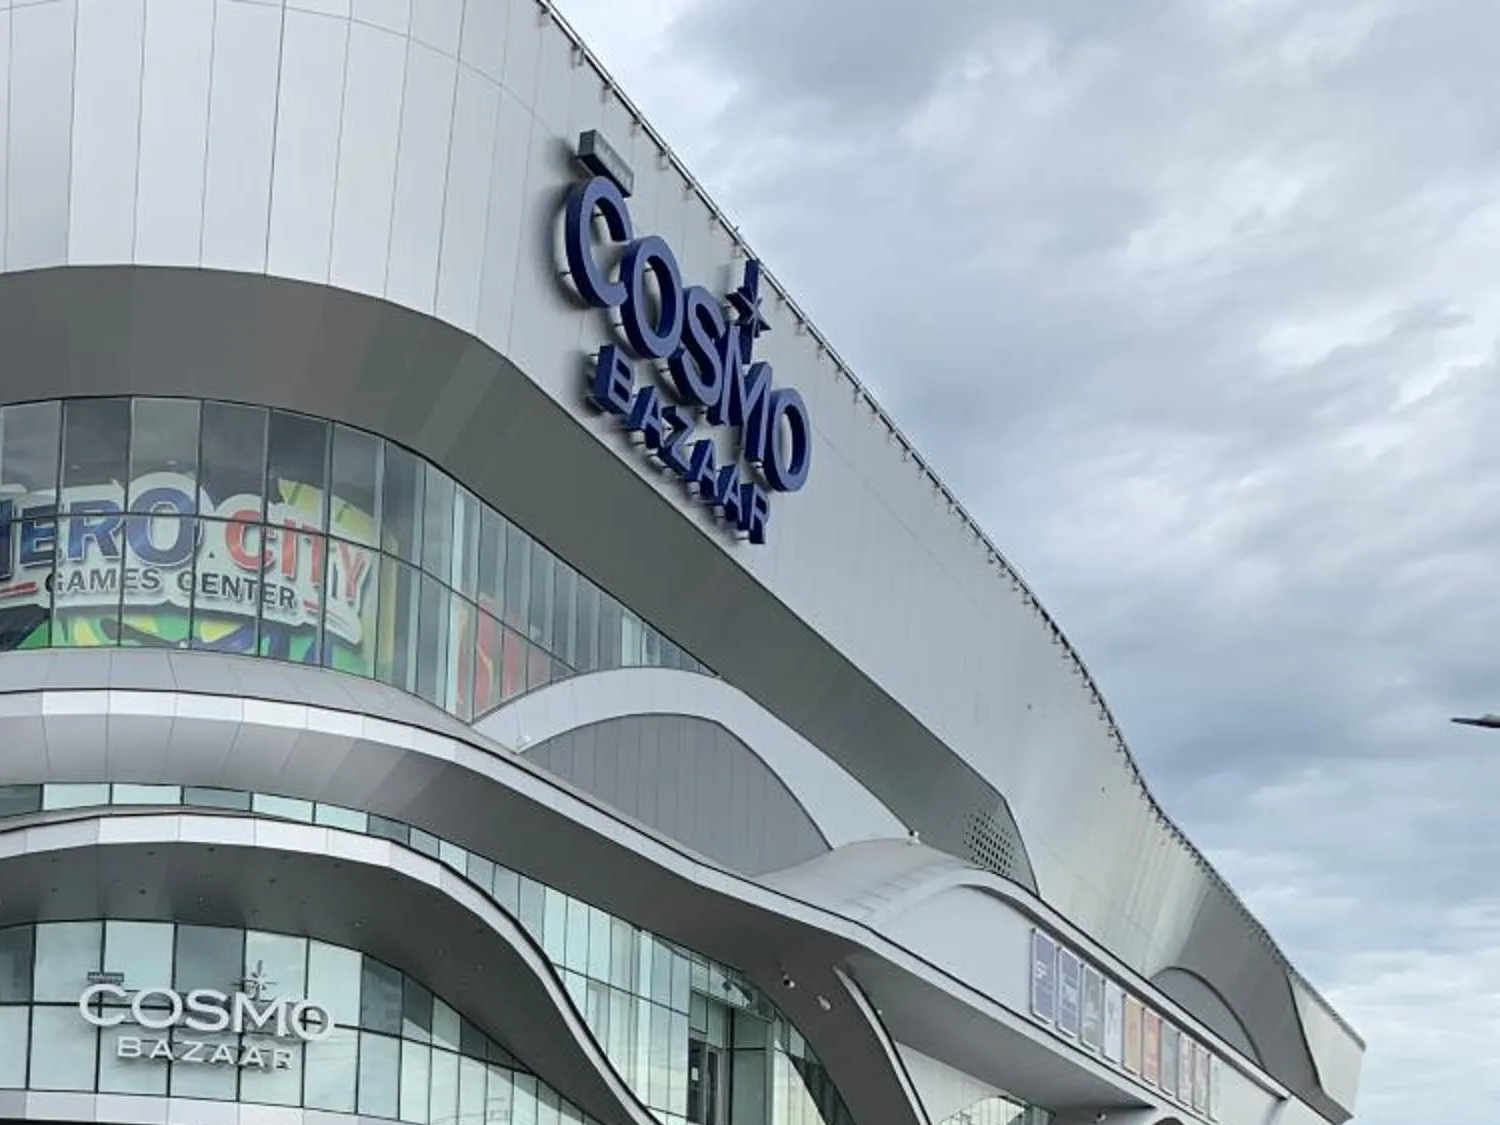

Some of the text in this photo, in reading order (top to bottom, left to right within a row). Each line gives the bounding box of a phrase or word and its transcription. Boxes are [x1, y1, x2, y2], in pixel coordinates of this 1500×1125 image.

[565, 176, 813, 493] COSMO
[590, 345, 772, 546] BAZAAR
[44, 567, 296, 609] GAMES CENTER
[225, 508, 368, 601] CITY
[79, 983, 334, 1042] COSMO
[116, 1037, 294, 1071] BAZAAR
